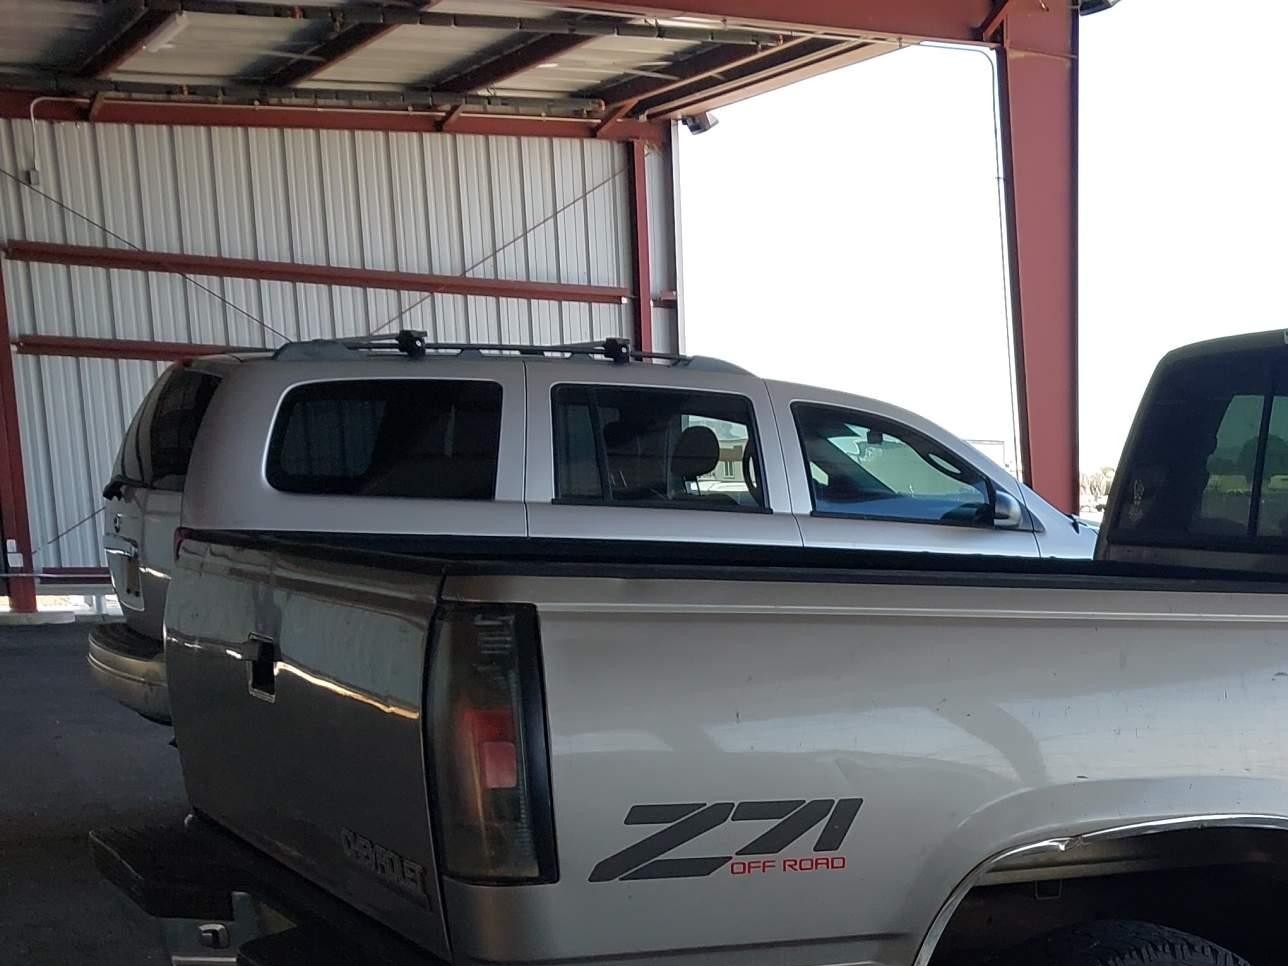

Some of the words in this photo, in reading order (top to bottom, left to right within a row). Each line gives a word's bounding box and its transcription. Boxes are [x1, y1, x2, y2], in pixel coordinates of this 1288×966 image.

[587, 798, 865, 883] Z71
[730, 859, 777, 875] OFF
[782, 856, 847, 873] ROAD
